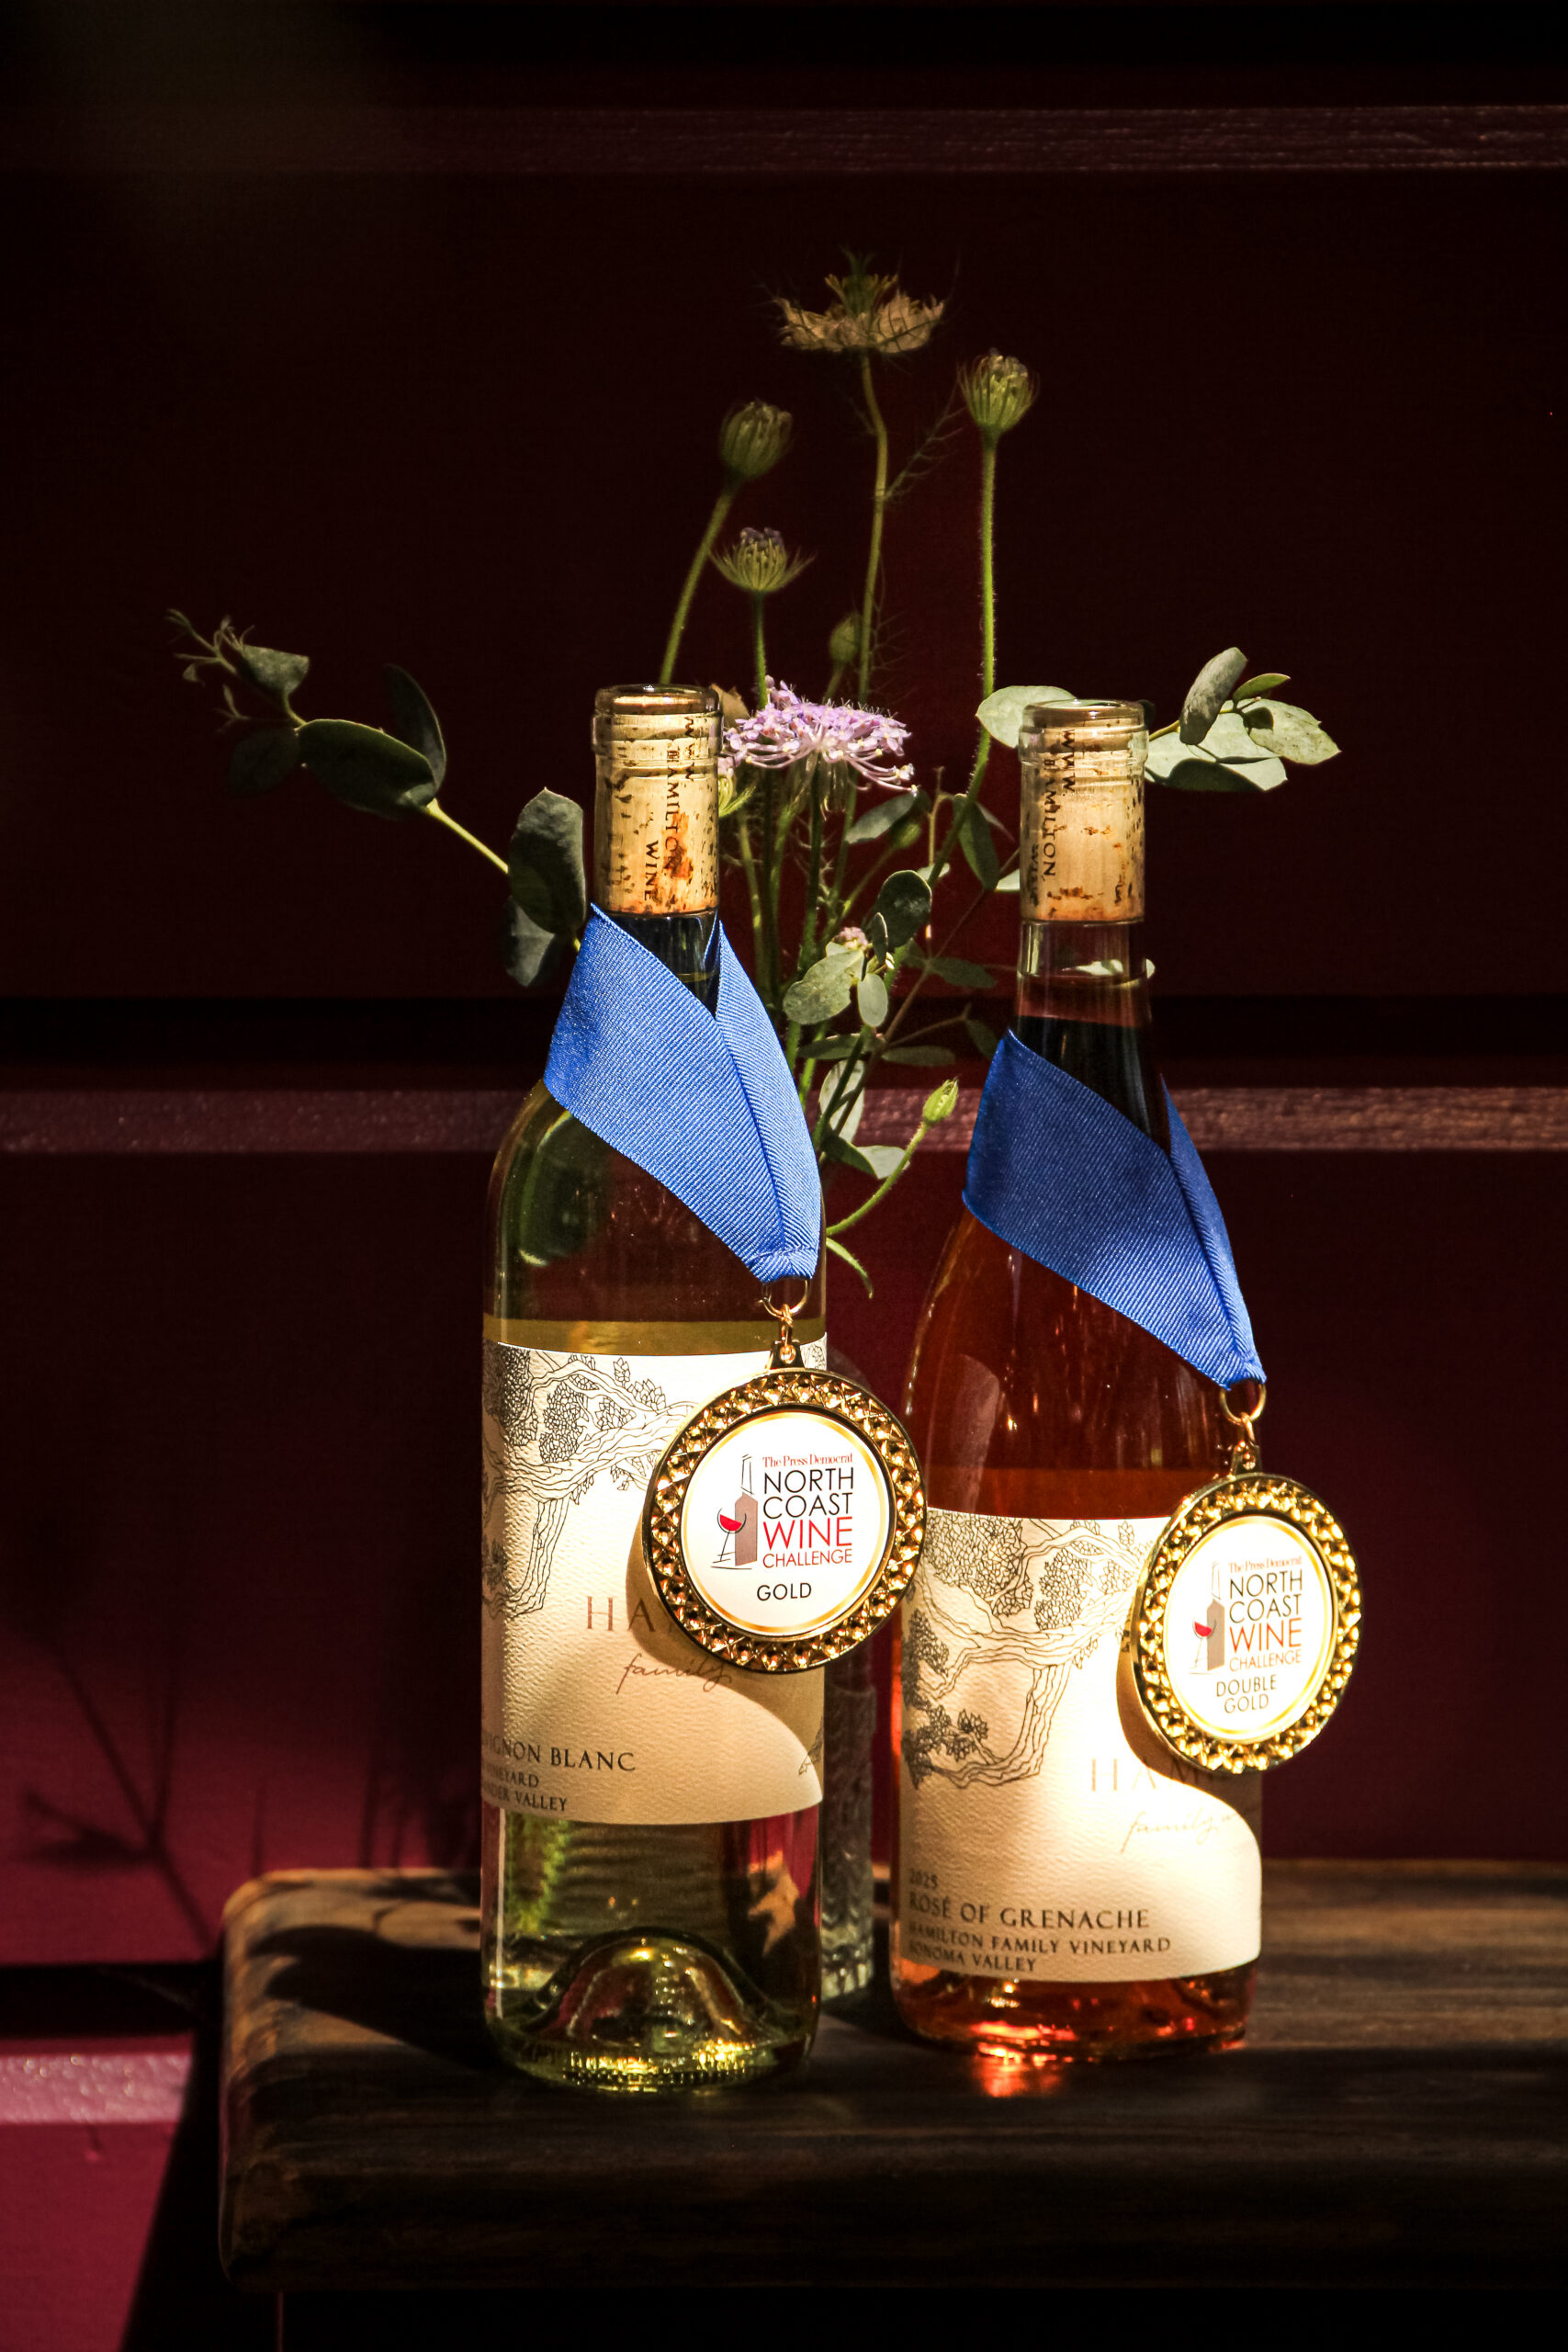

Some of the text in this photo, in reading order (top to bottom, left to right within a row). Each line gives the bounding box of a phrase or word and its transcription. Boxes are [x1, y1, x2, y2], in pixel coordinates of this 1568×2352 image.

[761, 1453, 852, 1467] The Press Democrat
[763, 1467, 853, 1494] NORTH
[763, 1492, 852, 1519] COAST
[762, 1516, 852, 1550] WINE
[762, 1549, 852, 1568] CHALLENGE
[1229, 1555, 1302, 1573] The Press Democrat
[757, 1582, 812, 1600] GOLD
[1230, 1568, 1303, 1599] NORTH
[1229, 1594, 1302, 1623] COAST
[1229, 1617, 1302, 1653] WINE
[1229, 1649, 1302, 1672] CHALLENGE
[616, 1653, 732, 1694] family
[1216, 1674, 1277, 1697] DOUBLE
[1224, 1693, 1269, 1713] GOLD
[551, 1747, 636, 1771] BLANC
[515, 1790, 567, 1812] VALLEY
[960, 1903, 990, 1923] OF
[999, 1907, 1150, 1929] GRENACHE
[908, 1921, 1170, 1954] HAMILTON FAMILY VINEYARD
[972, 1953, 1036, 1972] VALLEY
